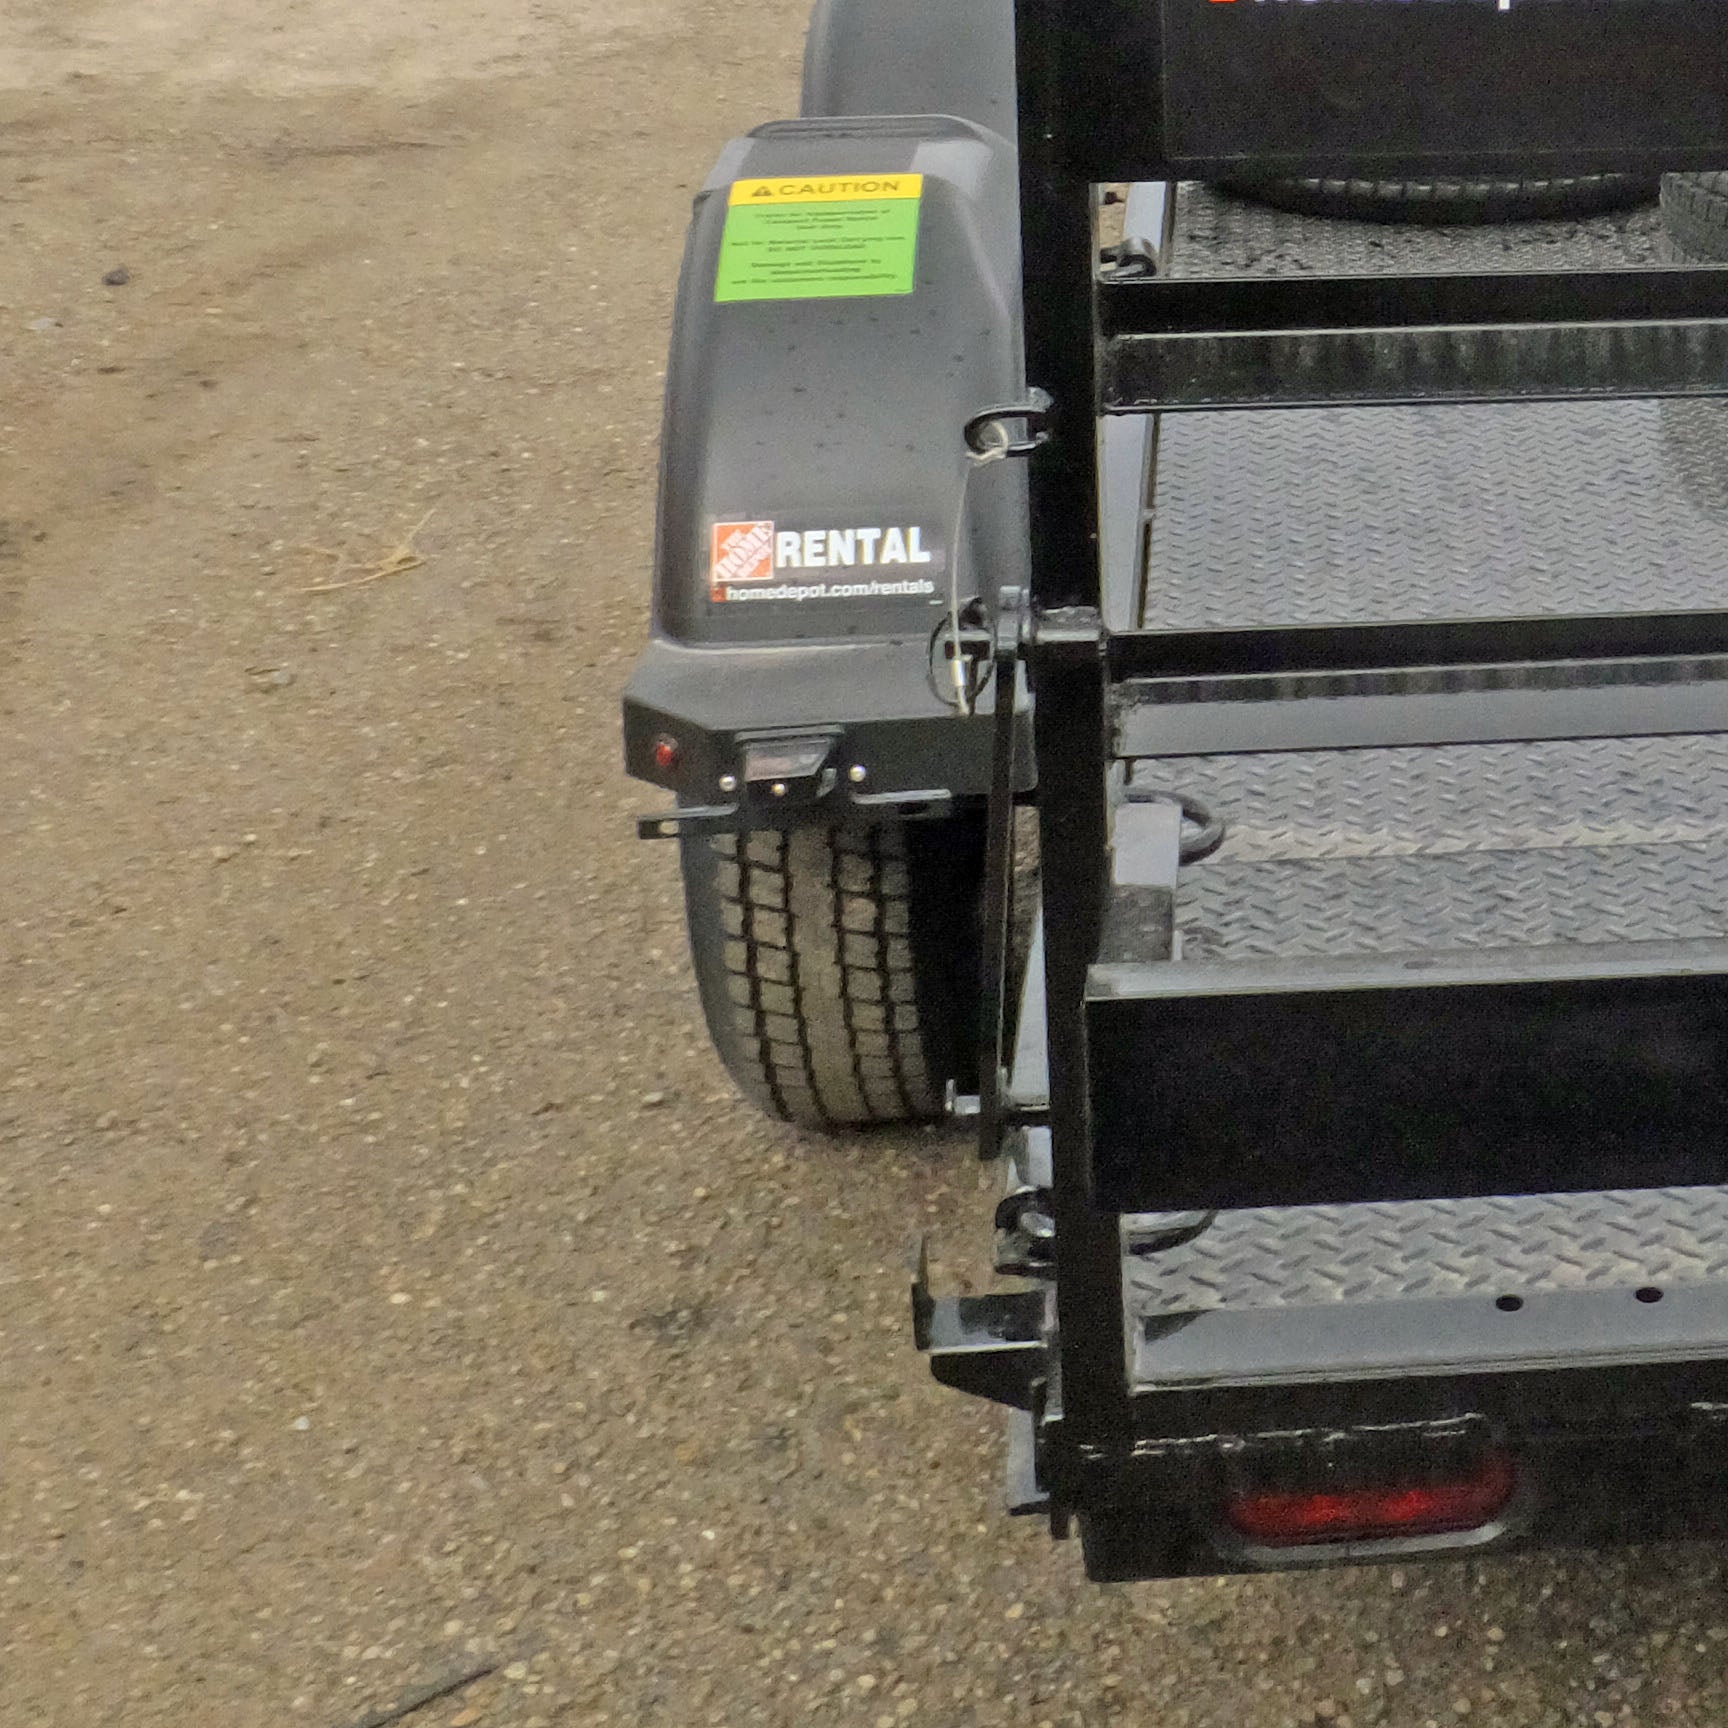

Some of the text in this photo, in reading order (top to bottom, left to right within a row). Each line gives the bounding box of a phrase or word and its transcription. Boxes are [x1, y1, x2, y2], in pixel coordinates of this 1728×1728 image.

[779, 180, 901, 196] CAUTION
[776, 526, 932, 569] RENTAL
[726, 578, 935, 602] homedepot.com/rentals
